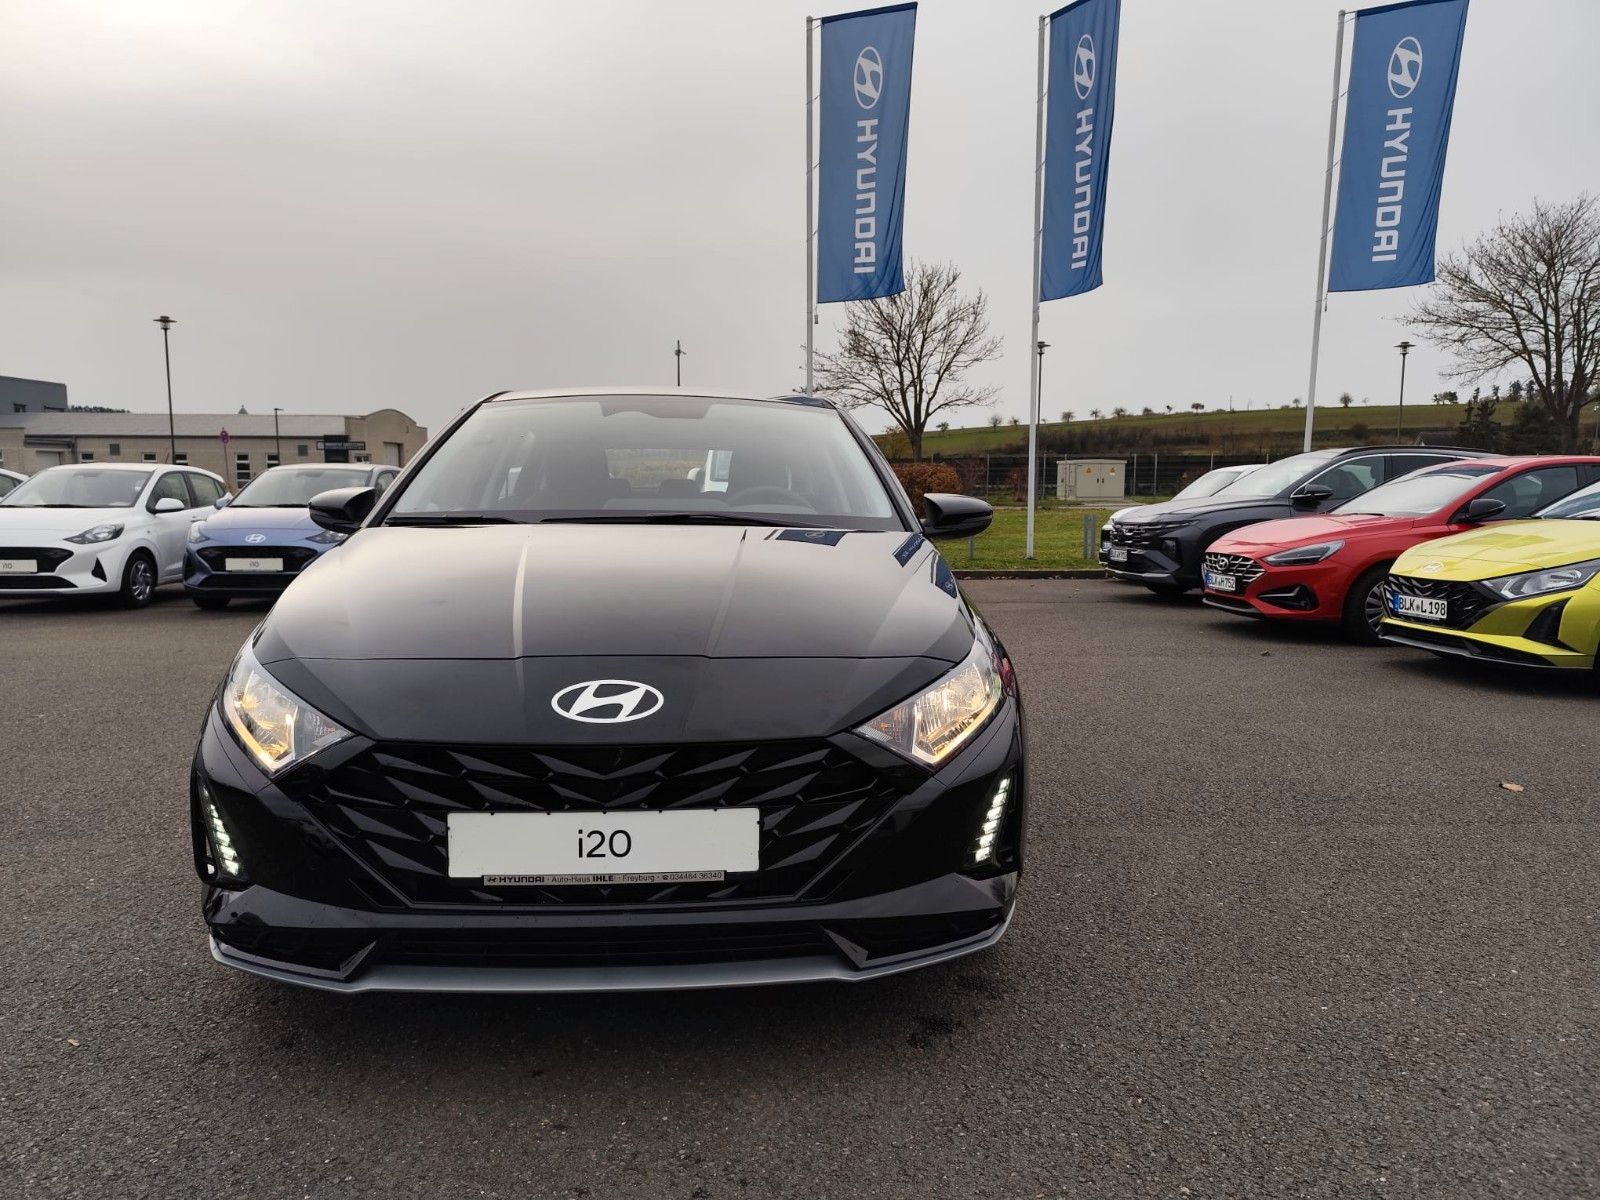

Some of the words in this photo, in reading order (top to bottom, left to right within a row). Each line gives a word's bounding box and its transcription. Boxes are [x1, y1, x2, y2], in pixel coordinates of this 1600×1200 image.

[854, 118, 879, 274] HYUNDAI
[1071, 108, 1094, 270] HYUNDAI
[1372, 107, 1413, 262] HYUNDAI
[1399, 597, 1415, 611] BLK
[1421, 600, 1427, 613] L
[1428, 601, 1446, 616] 198
[499, 875, 545, 884] HYUNDAI
[551, 875, 591, 884] Auto-Haus
[592, 874, 614, 883] IHLE
[622, 874, 655, 883] Freyburg
[698, 871, 722, 880] 36340
[578, 829, 632, 858] i20
